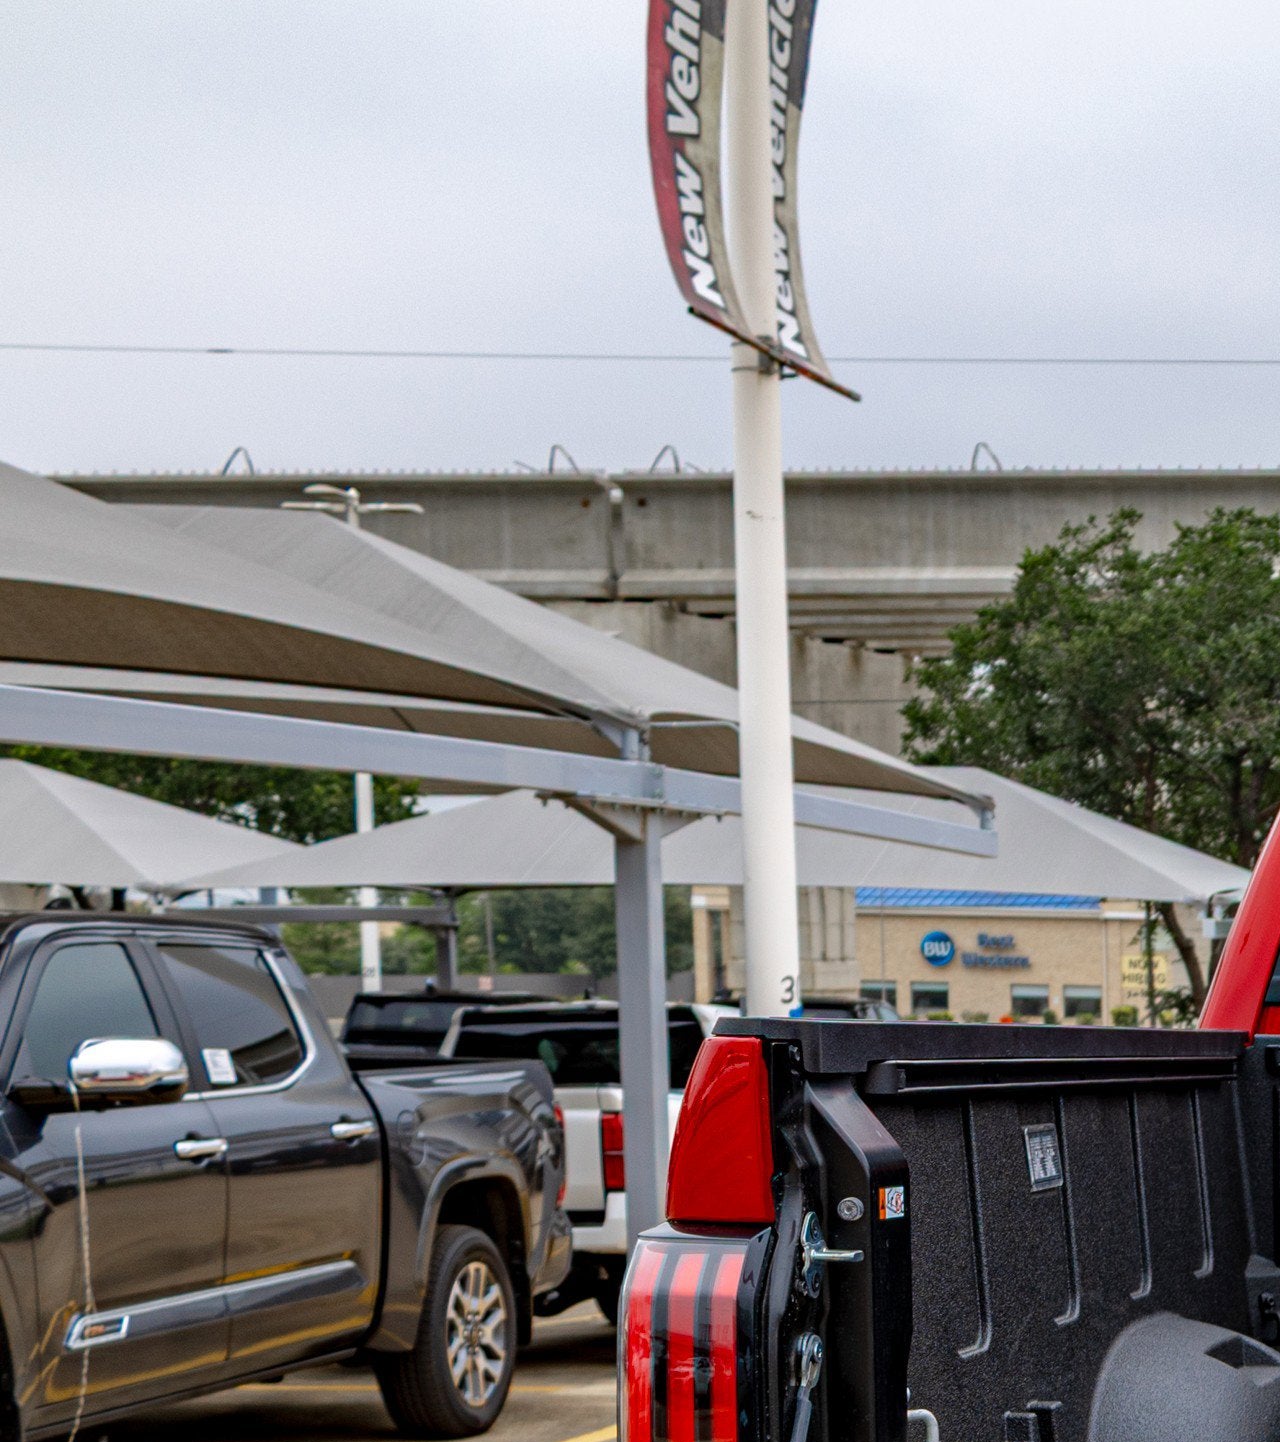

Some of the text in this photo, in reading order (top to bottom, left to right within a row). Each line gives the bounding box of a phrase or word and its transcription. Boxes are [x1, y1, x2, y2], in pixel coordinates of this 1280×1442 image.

[674, 150, 727, 308] New
[923, 941, 952, 957] BW
[780, 975, 795, 1004] 3
